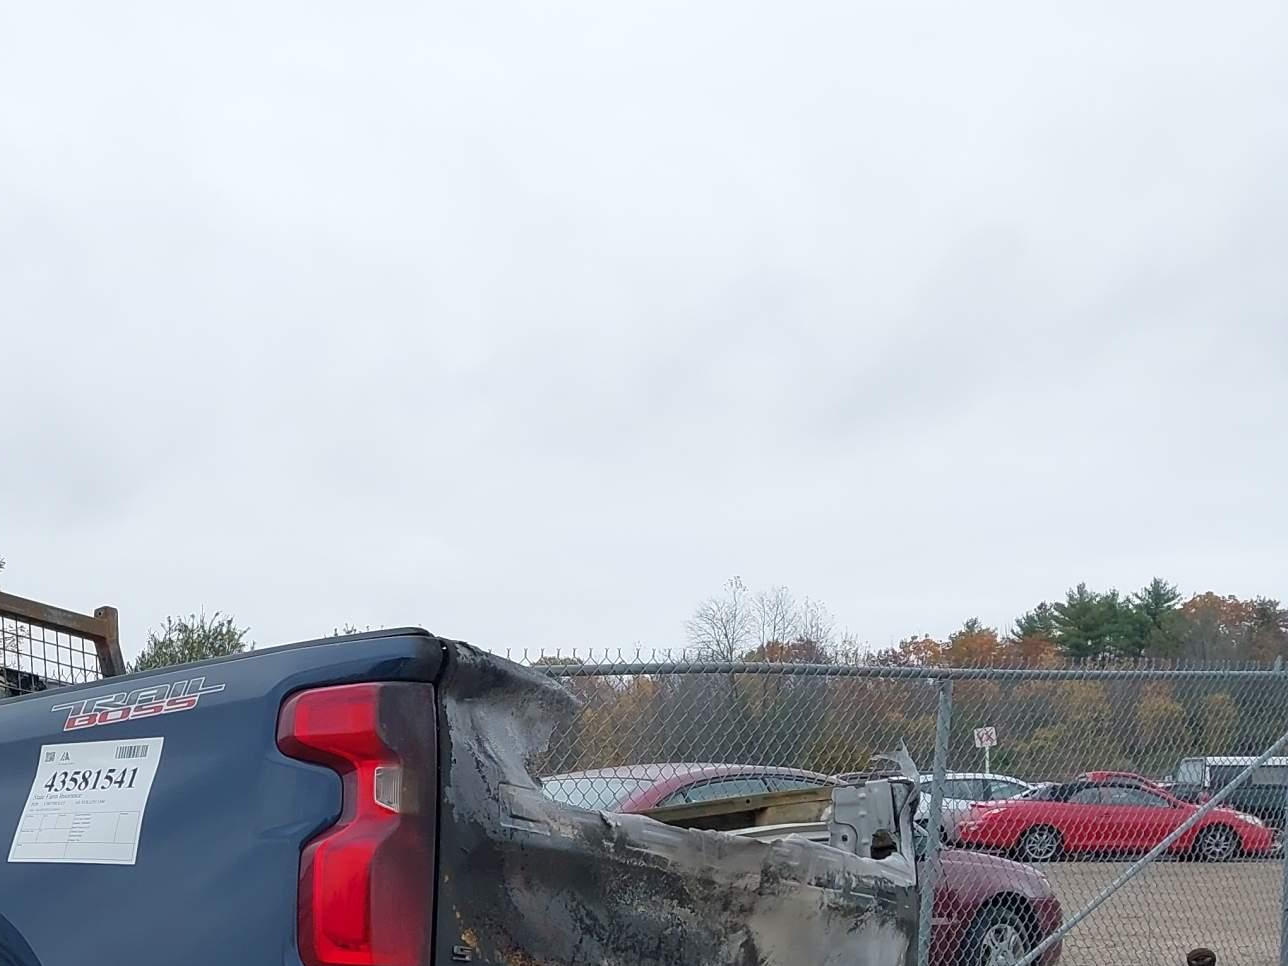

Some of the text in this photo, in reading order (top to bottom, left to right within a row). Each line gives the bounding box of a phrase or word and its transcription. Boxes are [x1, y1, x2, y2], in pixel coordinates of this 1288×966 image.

[51, 676, 226, 717] TRAIL
[63, 694, 200, 731] BOSS
[44, 767, 139, 793] 43581541
